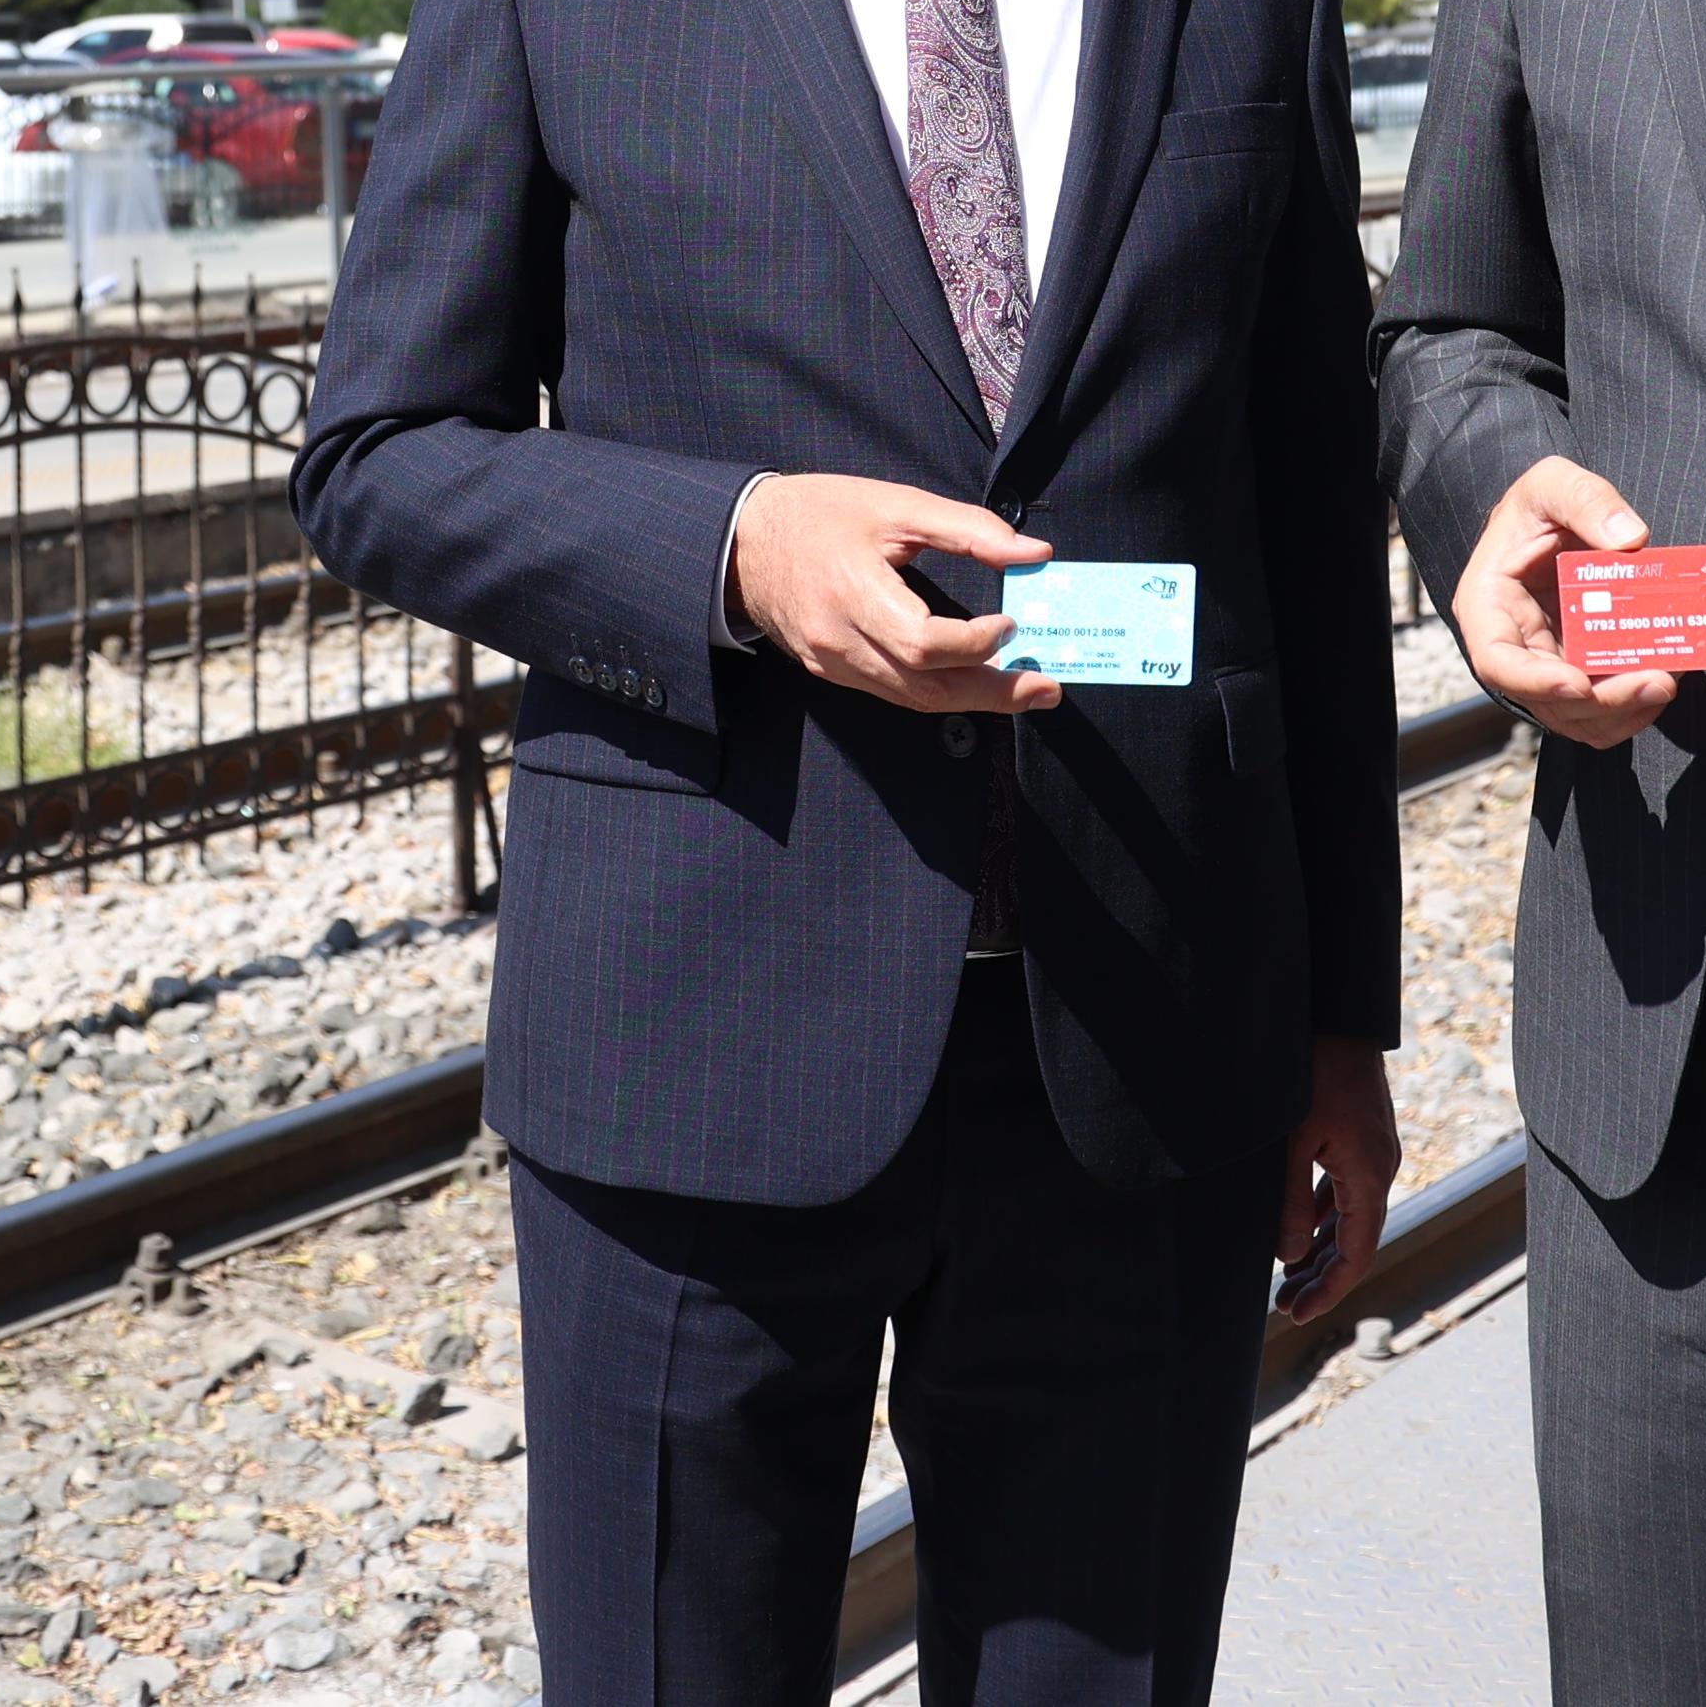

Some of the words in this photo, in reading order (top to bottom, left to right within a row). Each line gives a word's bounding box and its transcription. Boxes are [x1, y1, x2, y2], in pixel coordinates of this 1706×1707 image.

[1584, 619, 1616, 631] 9792
[1618, 617, 1650, 629] 5900
[1653, 616, 1684, 628] 0011
[1018, 626, 1044, 636] 9792
[1046, 627, 1071, 637] 5400
[1074, 627, 1098, 637] 0012
[1101, 628, 1126, 637] 8098
[1141, 659, 1182, 679] troy
